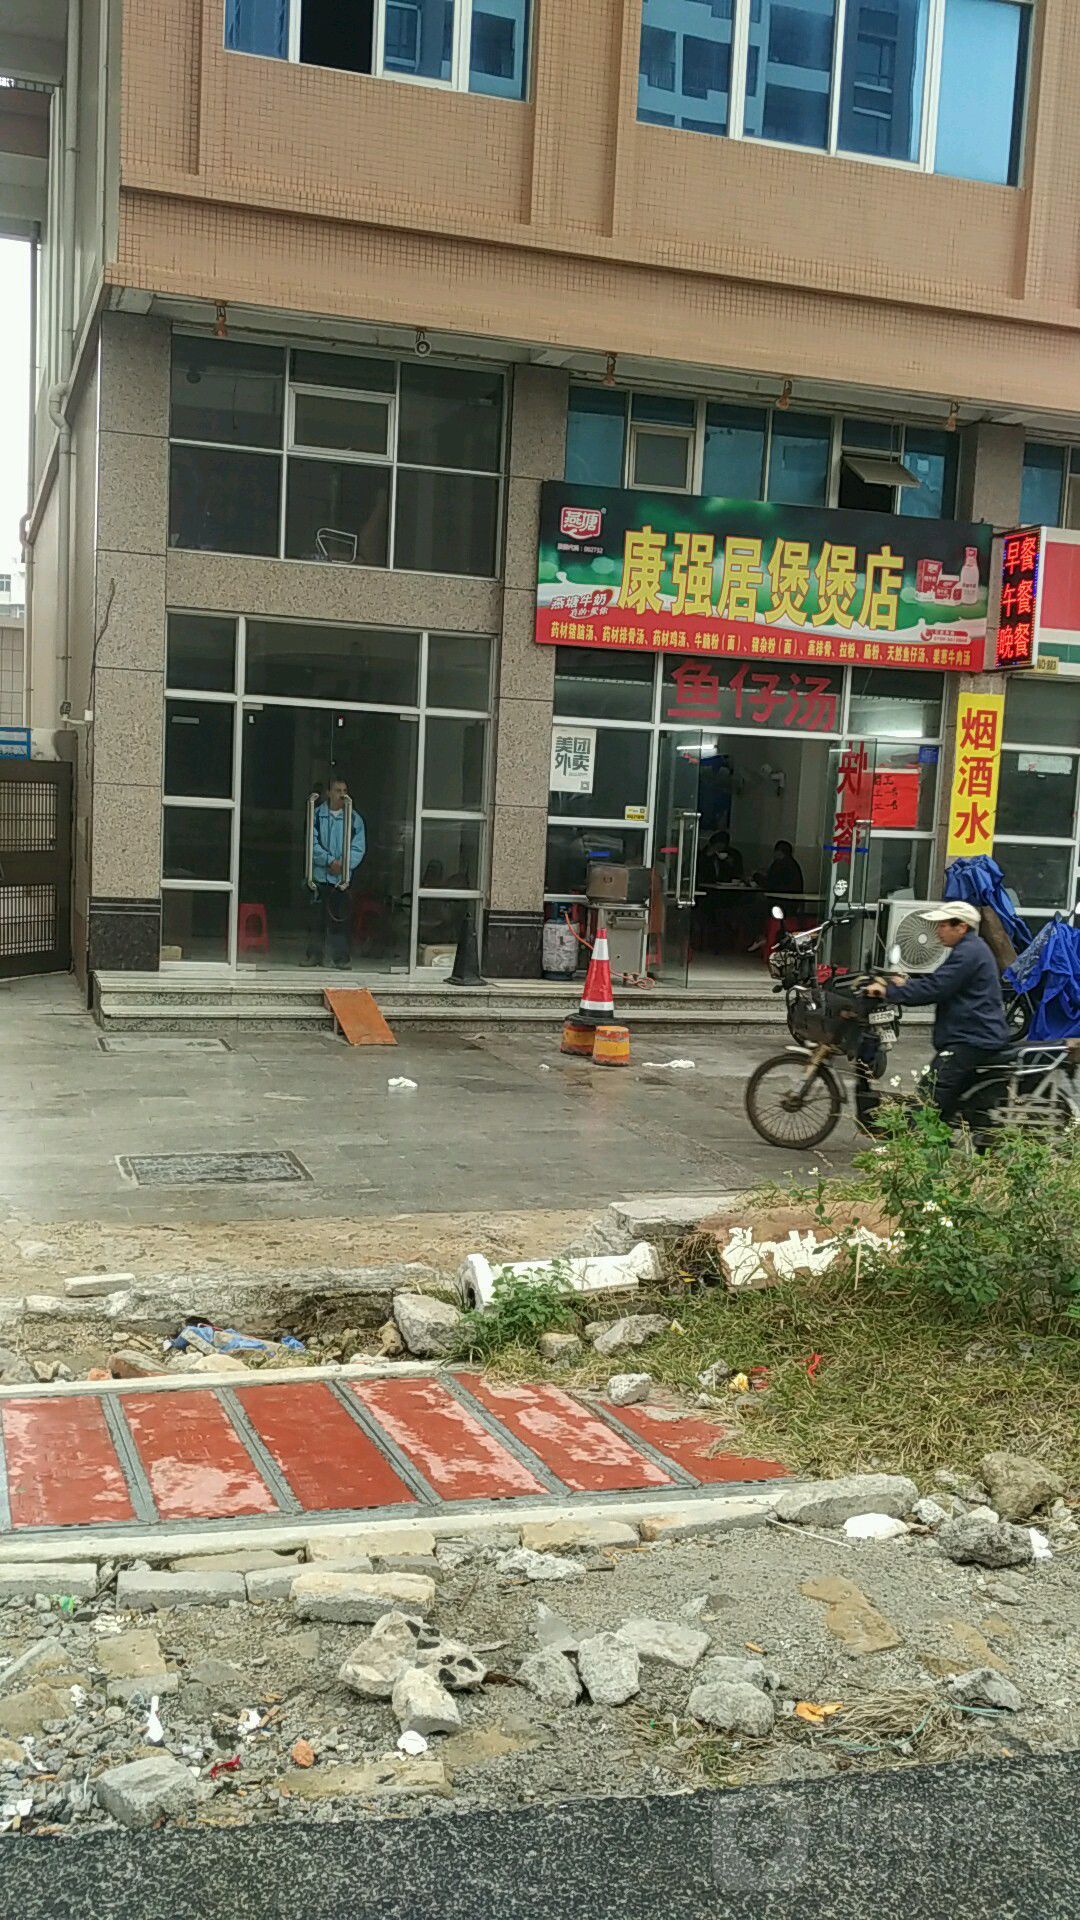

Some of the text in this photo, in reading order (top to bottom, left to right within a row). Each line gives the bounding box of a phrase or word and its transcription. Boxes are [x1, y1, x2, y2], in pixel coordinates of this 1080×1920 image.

[1005, 537, 1037, 575] 早餐
[617, 525, 904, 631] 康强居煲煲店
[1002, 580, 1034, 617] 午餐
[999, 622, 1030, 659] 晚餐
[667, 659, 837, 732] 鱼仔汤
[554, 736, 591, 754] 美团
[554, 753, 590, 776] 外卖
[954, 707, 998, 844] 烟酒水
